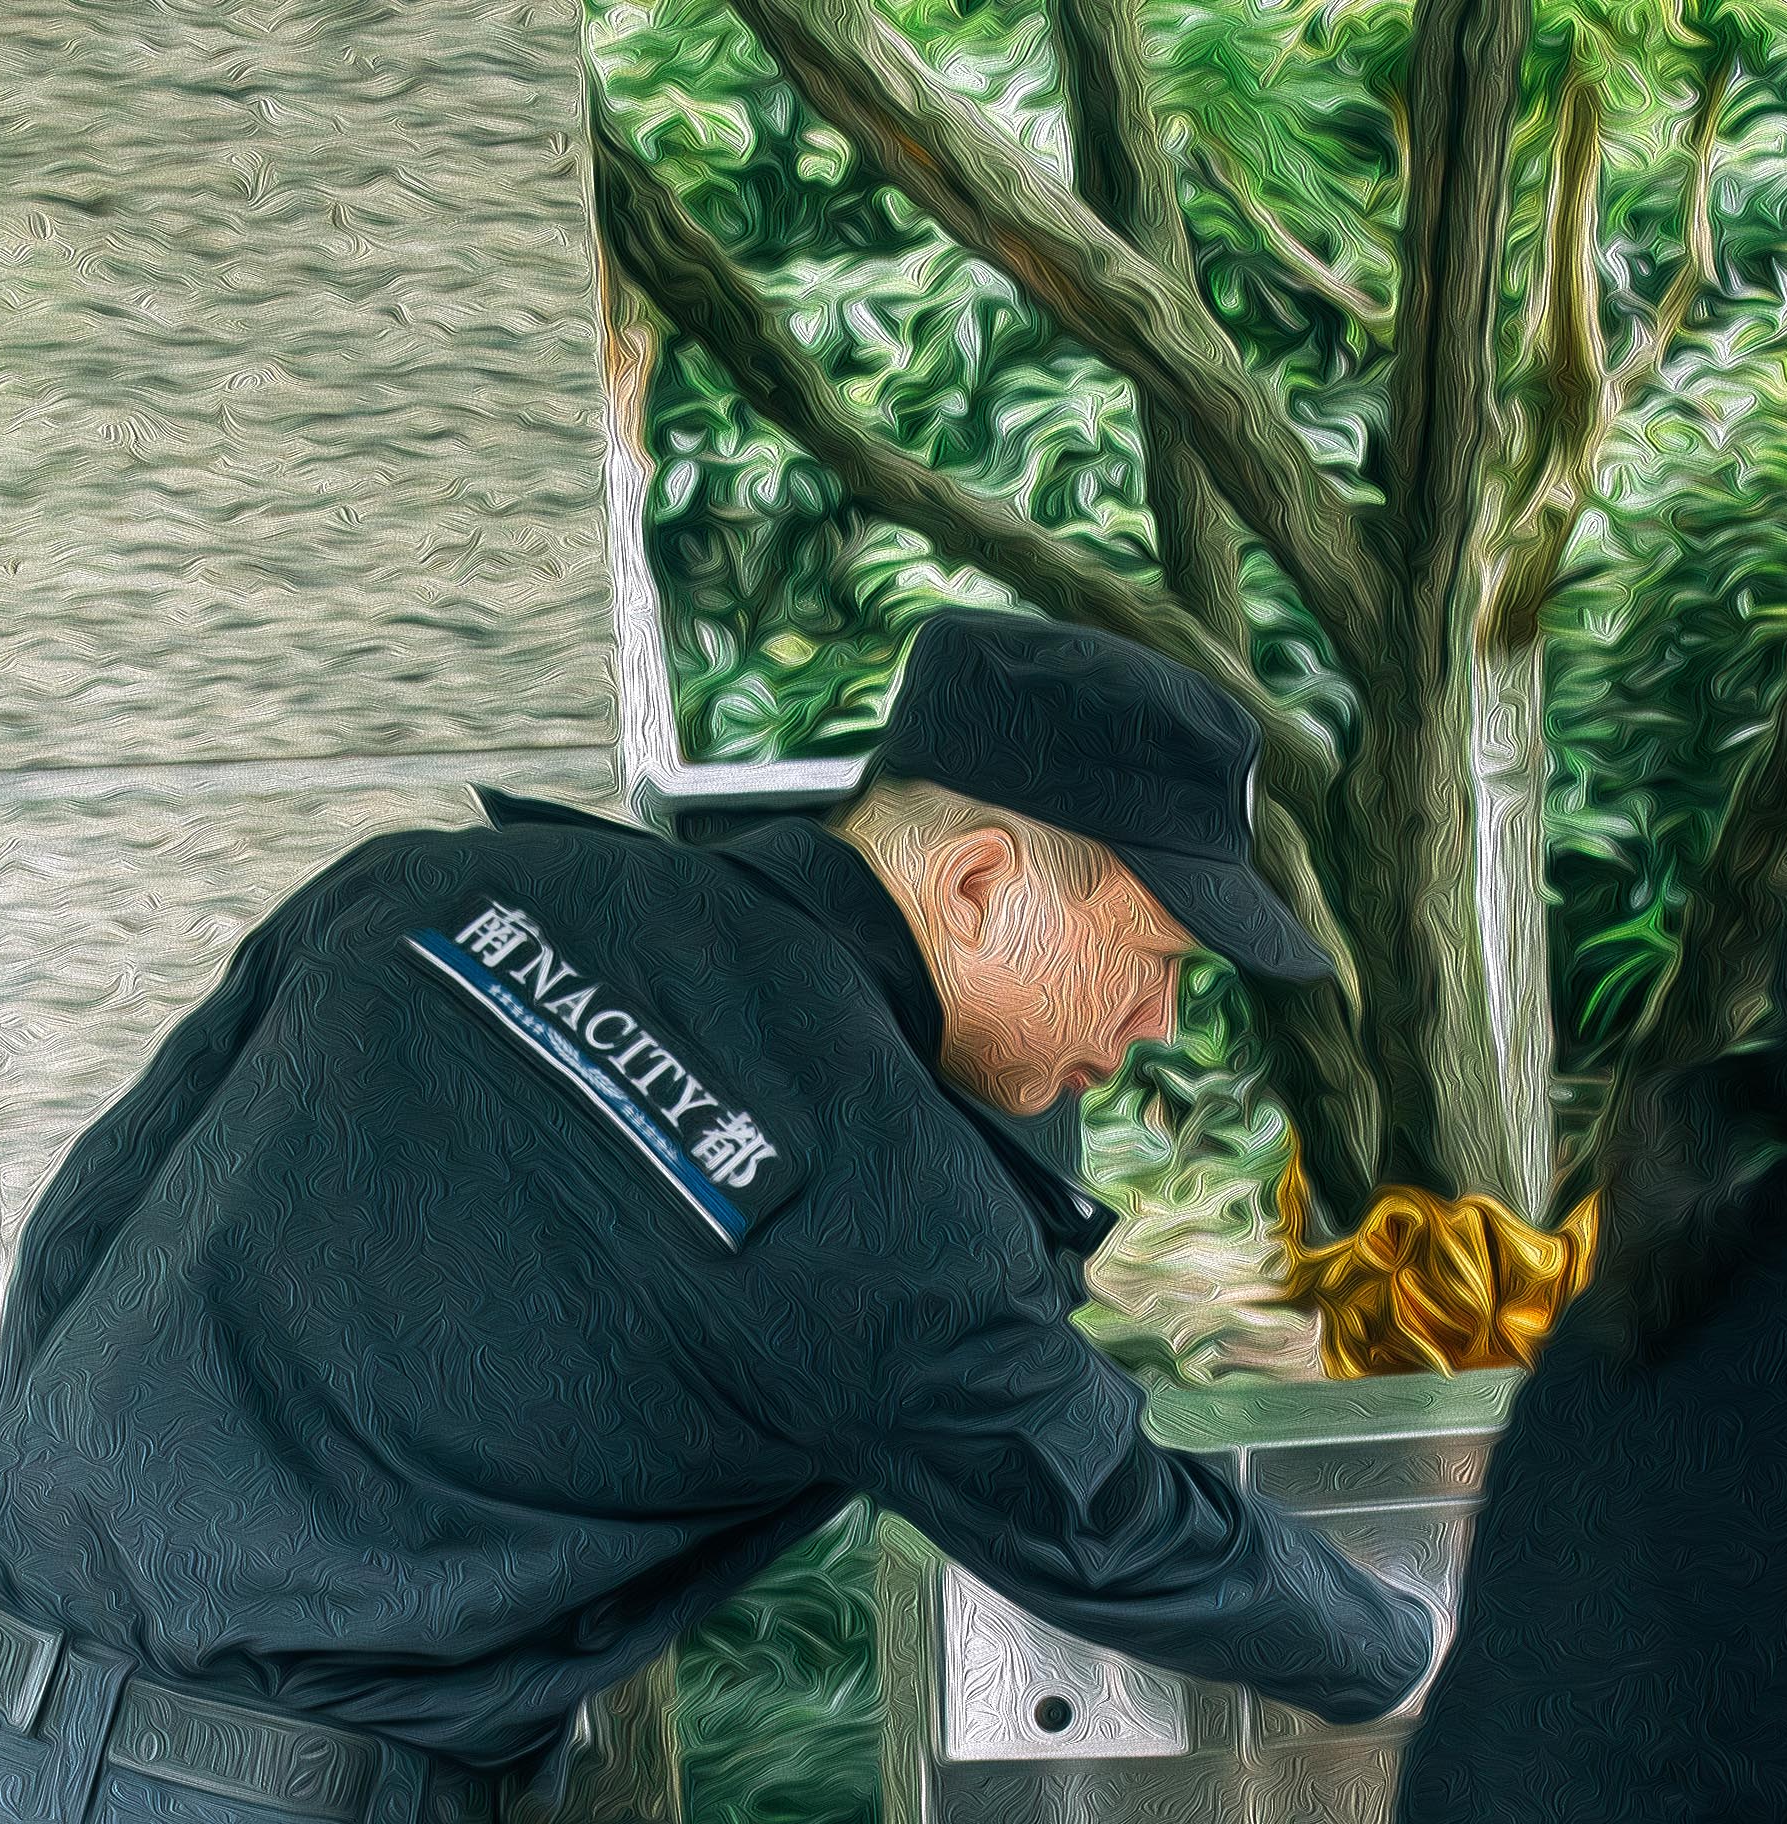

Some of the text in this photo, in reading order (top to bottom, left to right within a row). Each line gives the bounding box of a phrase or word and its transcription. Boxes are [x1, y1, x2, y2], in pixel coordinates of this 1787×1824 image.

[455, 899, 777, 1187] 南 NACITY 都
